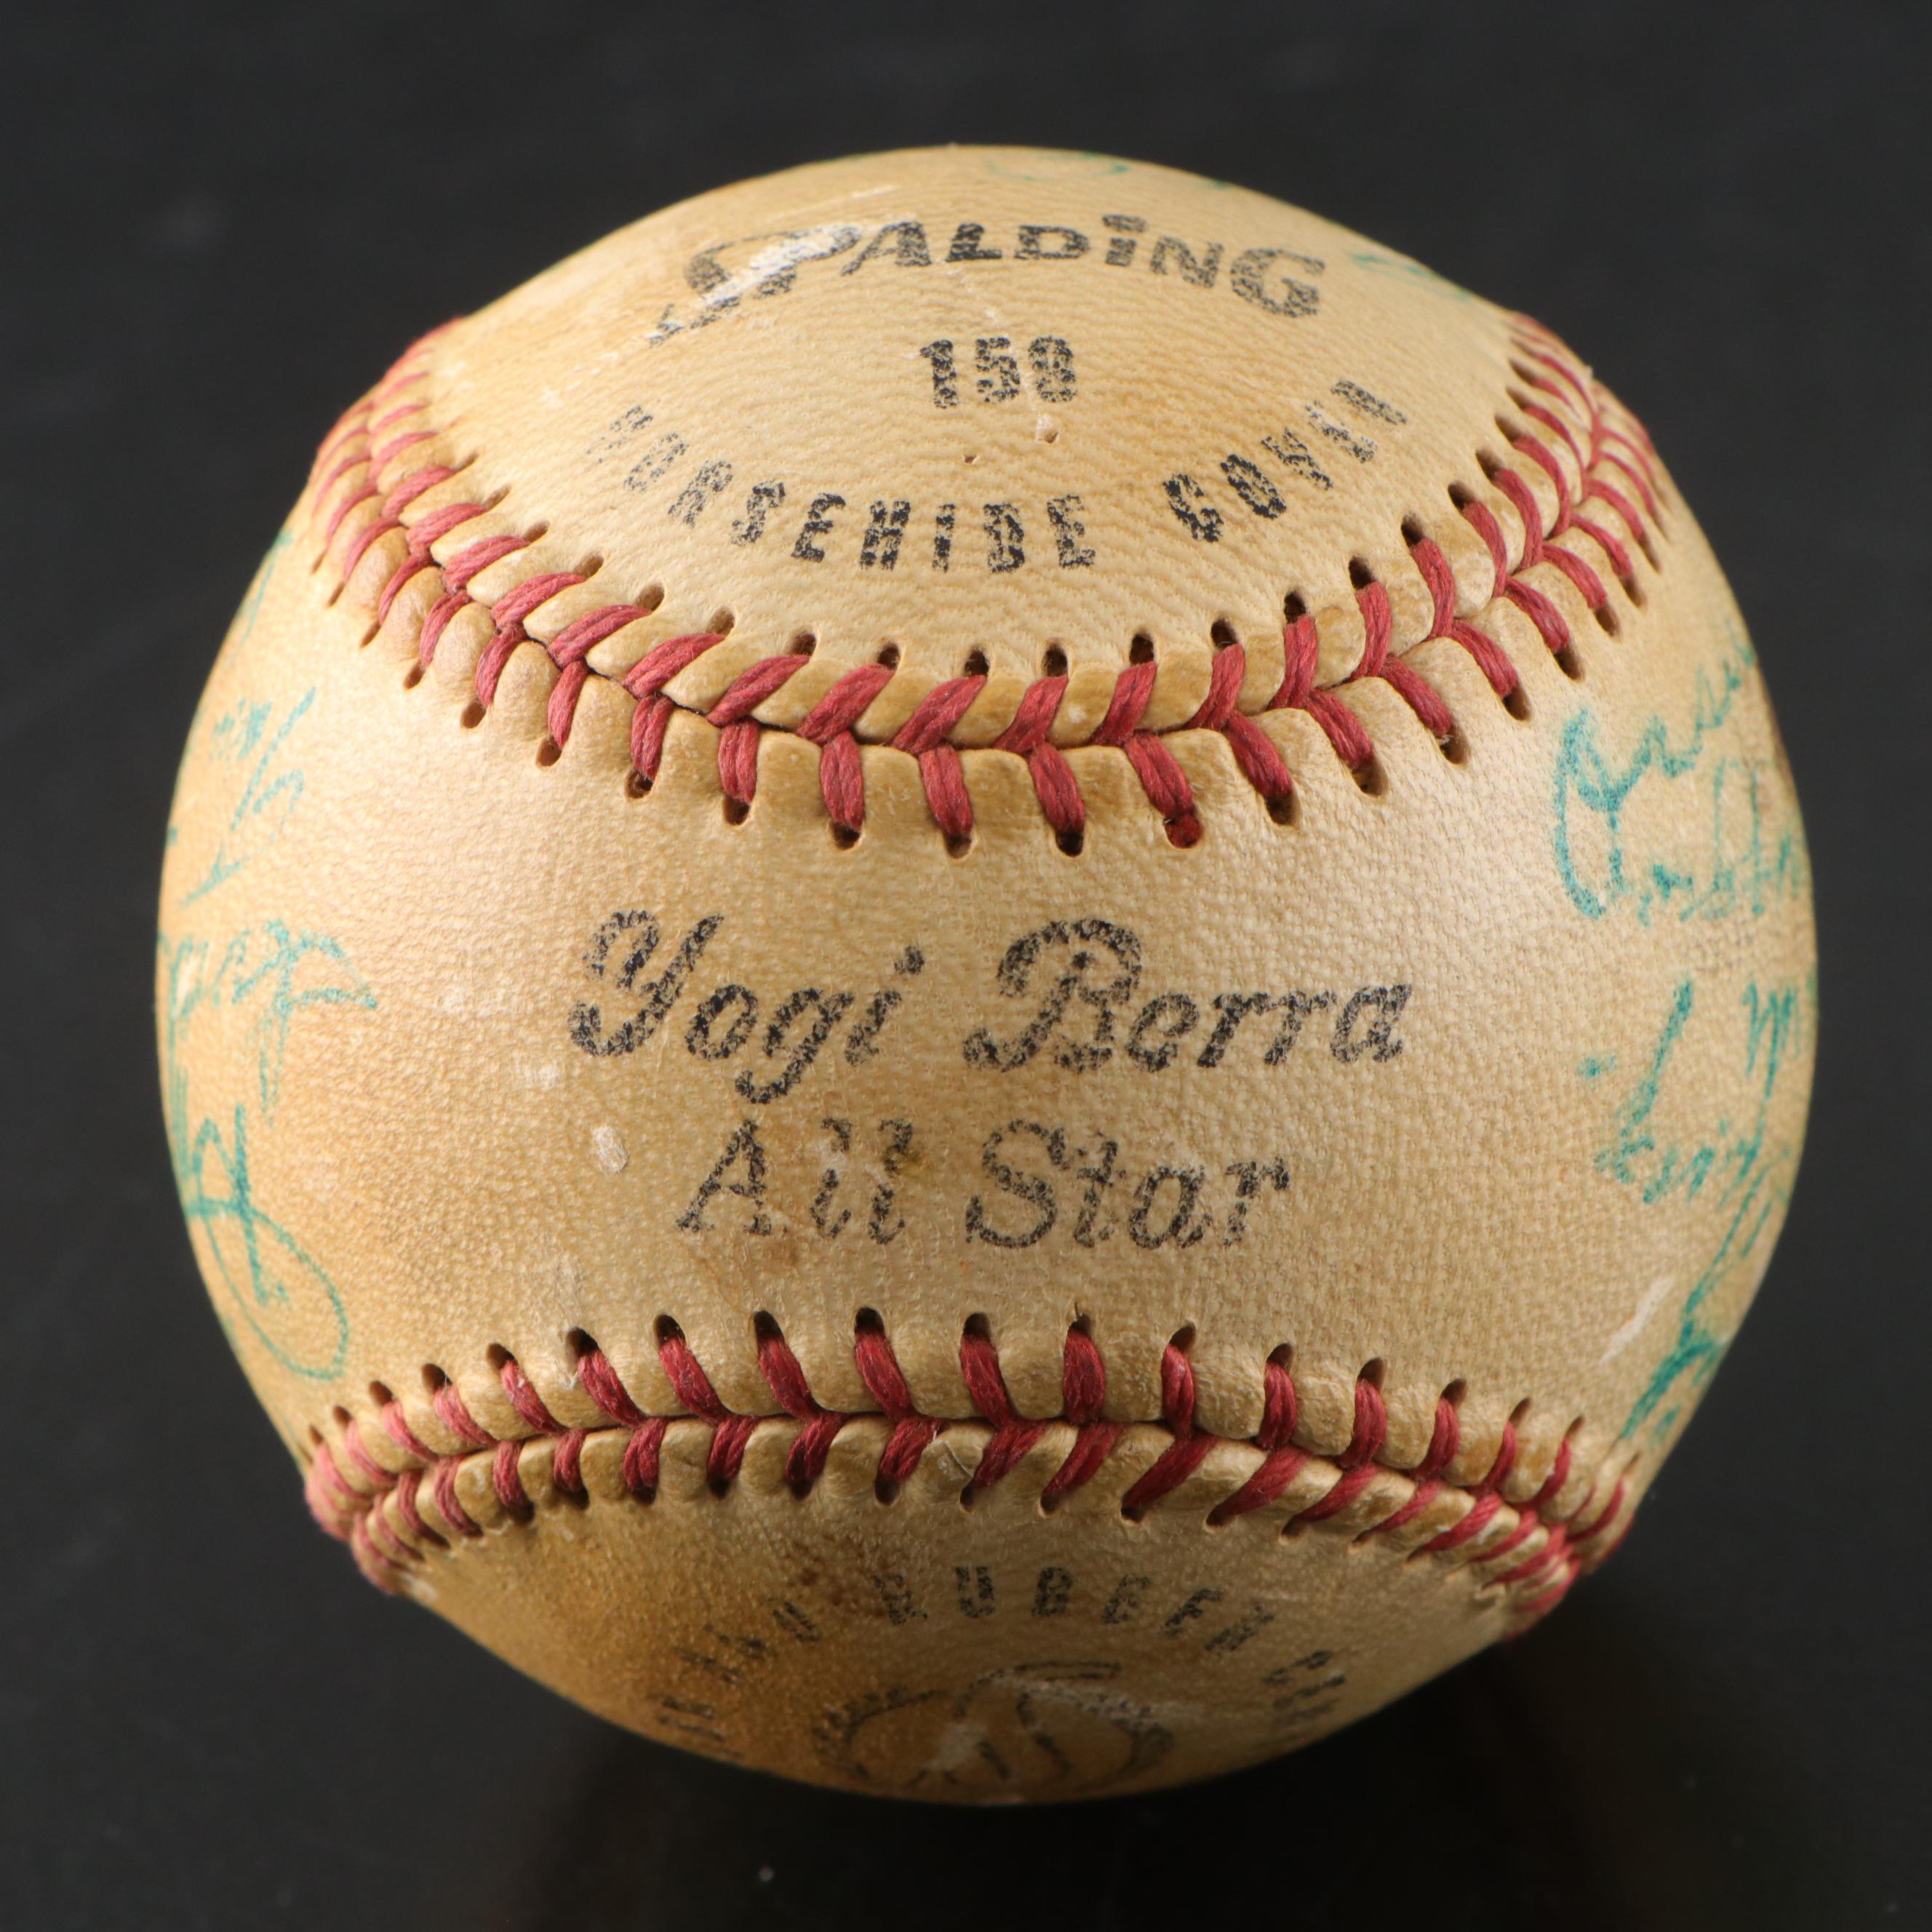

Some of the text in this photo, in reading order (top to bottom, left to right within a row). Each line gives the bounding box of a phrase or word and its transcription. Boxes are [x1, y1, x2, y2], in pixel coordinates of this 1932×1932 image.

[568, 909, 1413, 1104] Yogi Berra
[676, 1118, 1290, 1249] All Star
